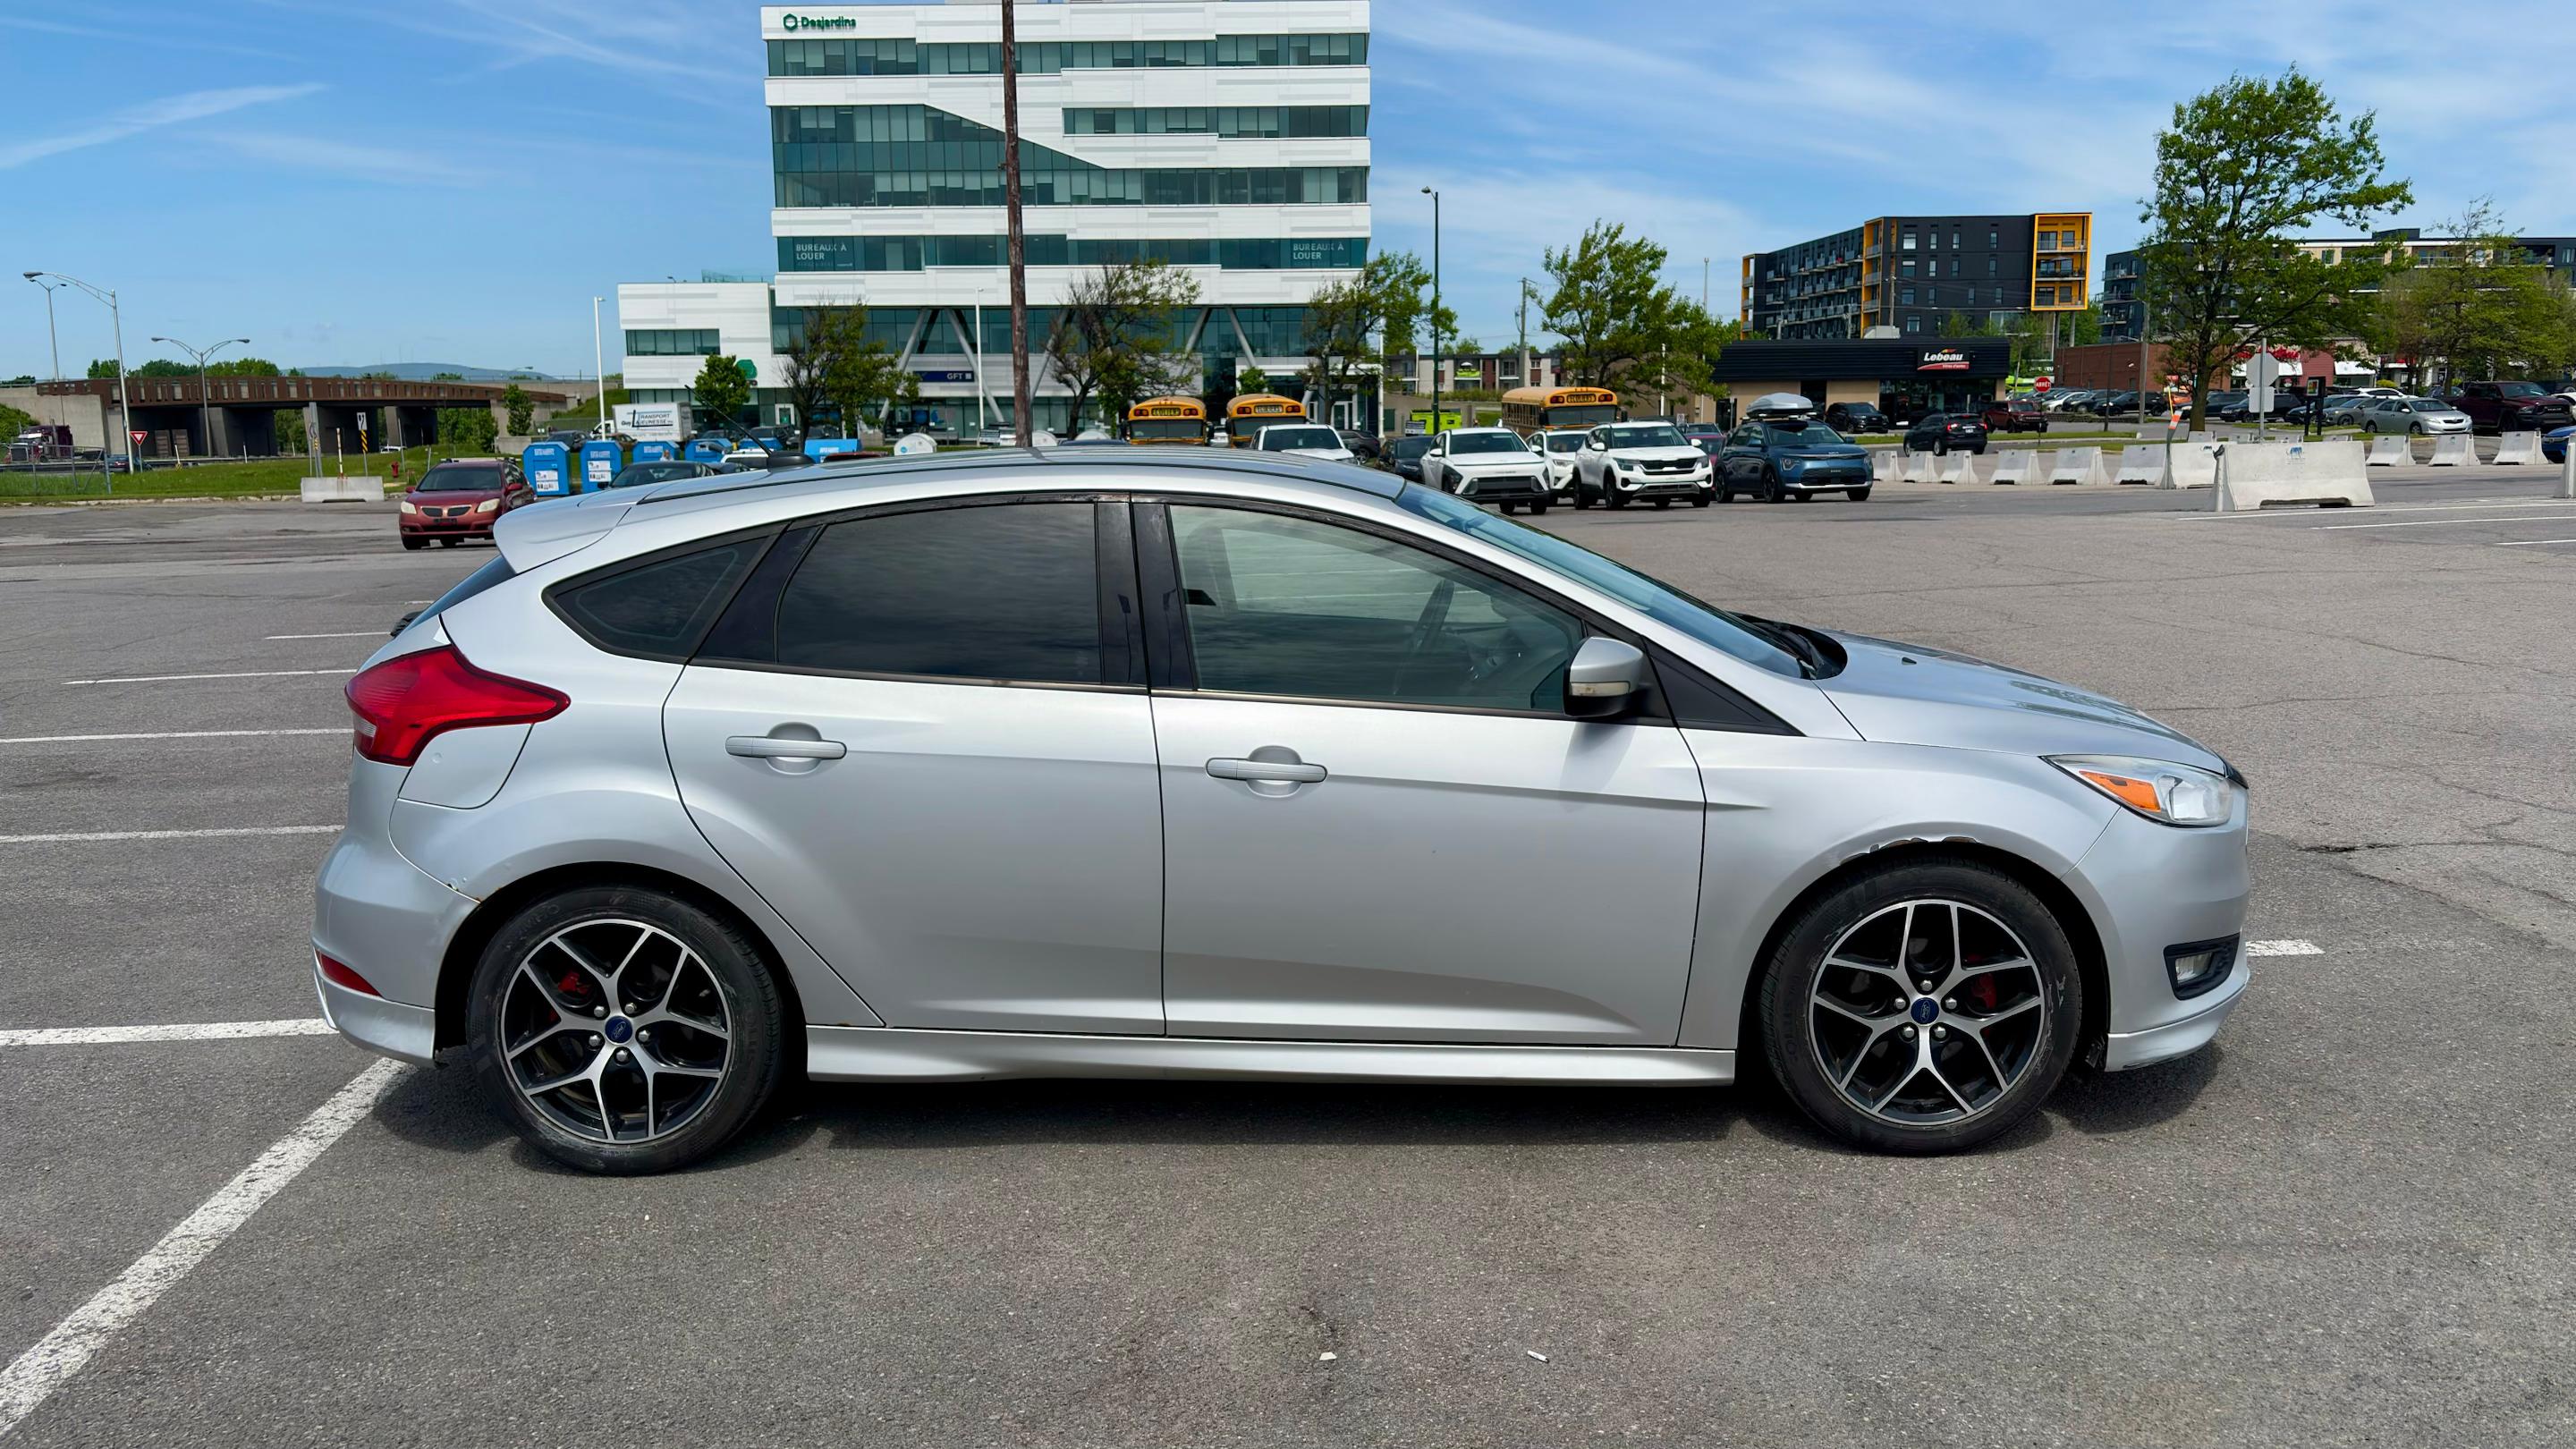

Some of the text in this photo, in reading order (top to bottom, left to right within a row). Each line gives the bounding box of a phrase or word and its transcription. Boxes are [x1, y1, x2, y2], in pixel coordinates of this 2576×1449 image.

[801, 15, 857, 30] Desjardins
[796, 243, 837, 251] BUREAUX
[1293, 243, 1335, 251] BUREAUX
[796, 252, 825, 260] LOUER
[1293, 251, 1322, 259] LOUER
[1923, 352, 1963, 361] Lebeau
[946, 372, 964, 380] GFT
